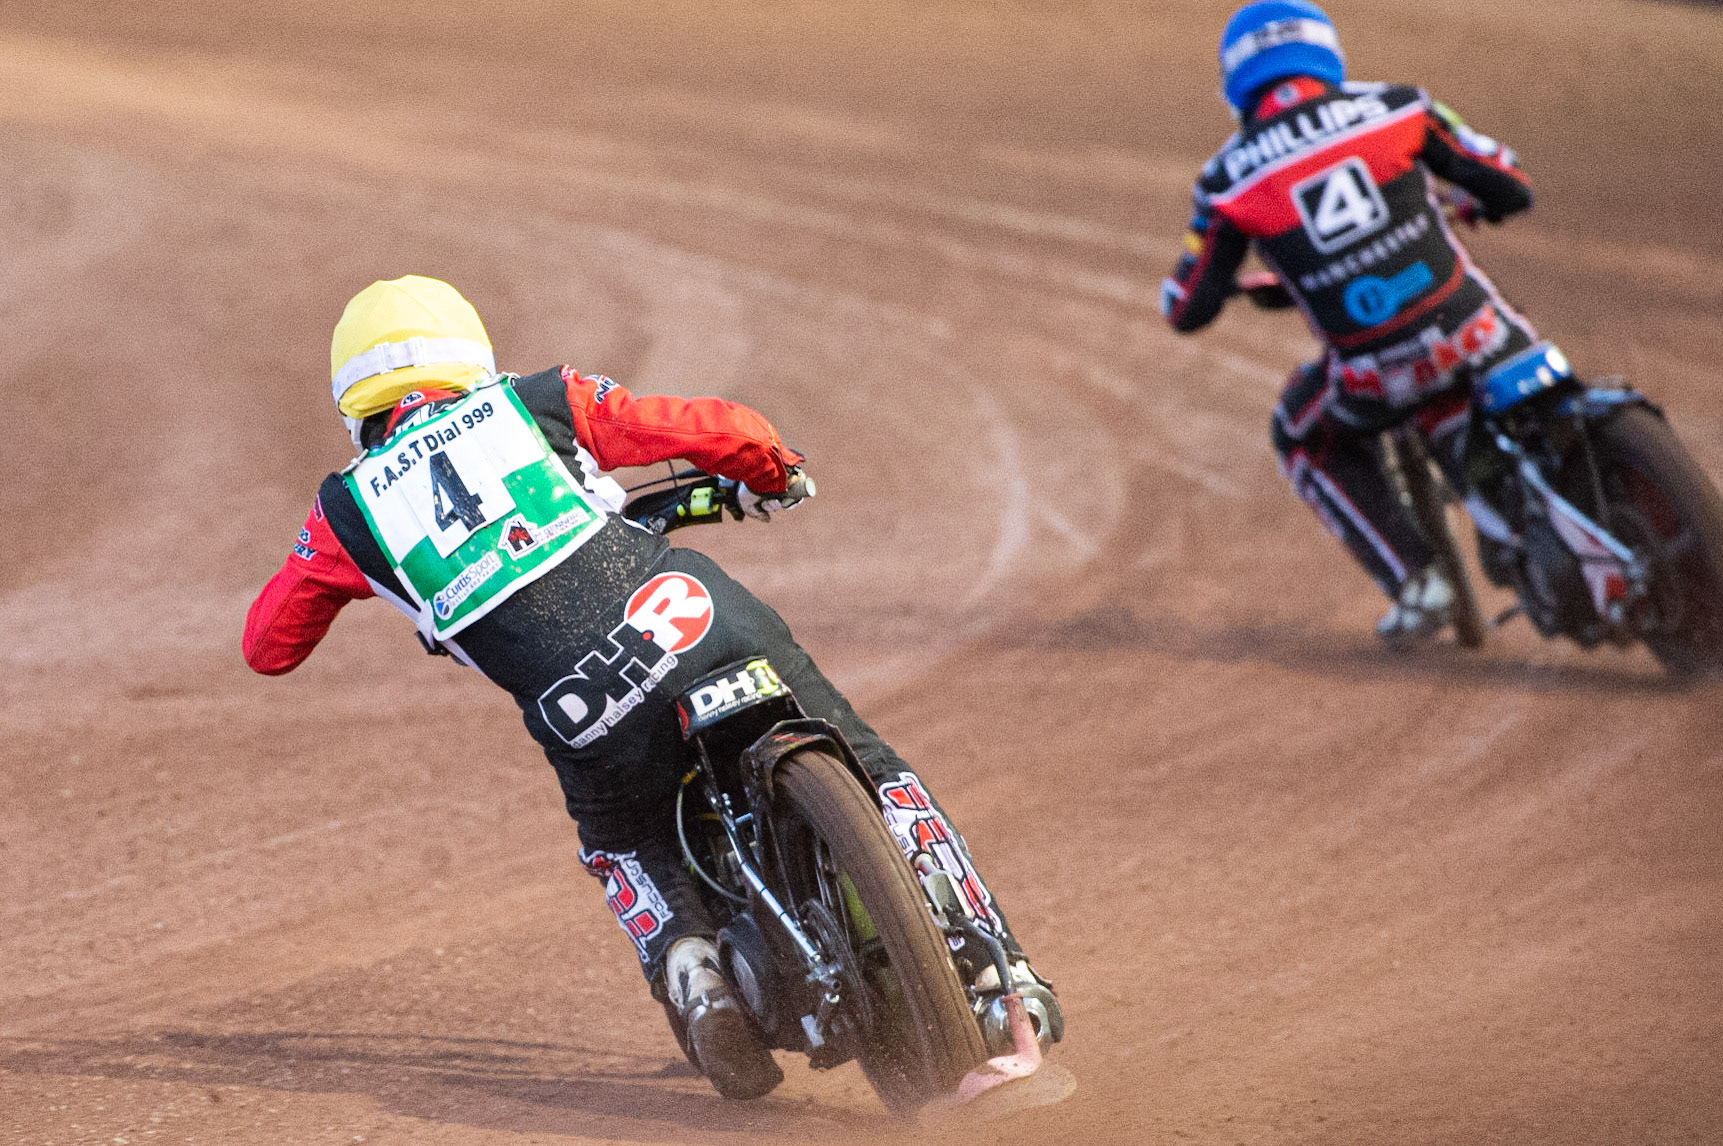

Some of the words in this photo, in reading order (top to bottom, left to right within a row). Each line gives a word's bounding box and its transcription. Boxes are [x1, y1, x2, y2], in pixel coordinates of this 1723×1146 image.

[1225, 97, 1391, 181] PHILLIPS
[1314, 165, 1376, 235] 4
[370, 440, 424, 497] F.A.S.T
[423, 421, 461, 452] Dial
[462, 402, 494, 429] 999
[429, 451, 486, 532] 4
[572, 721, 606, 748] danny
[605, 688, 643, 726] halsey
[643, 654, 677, 692] racing
